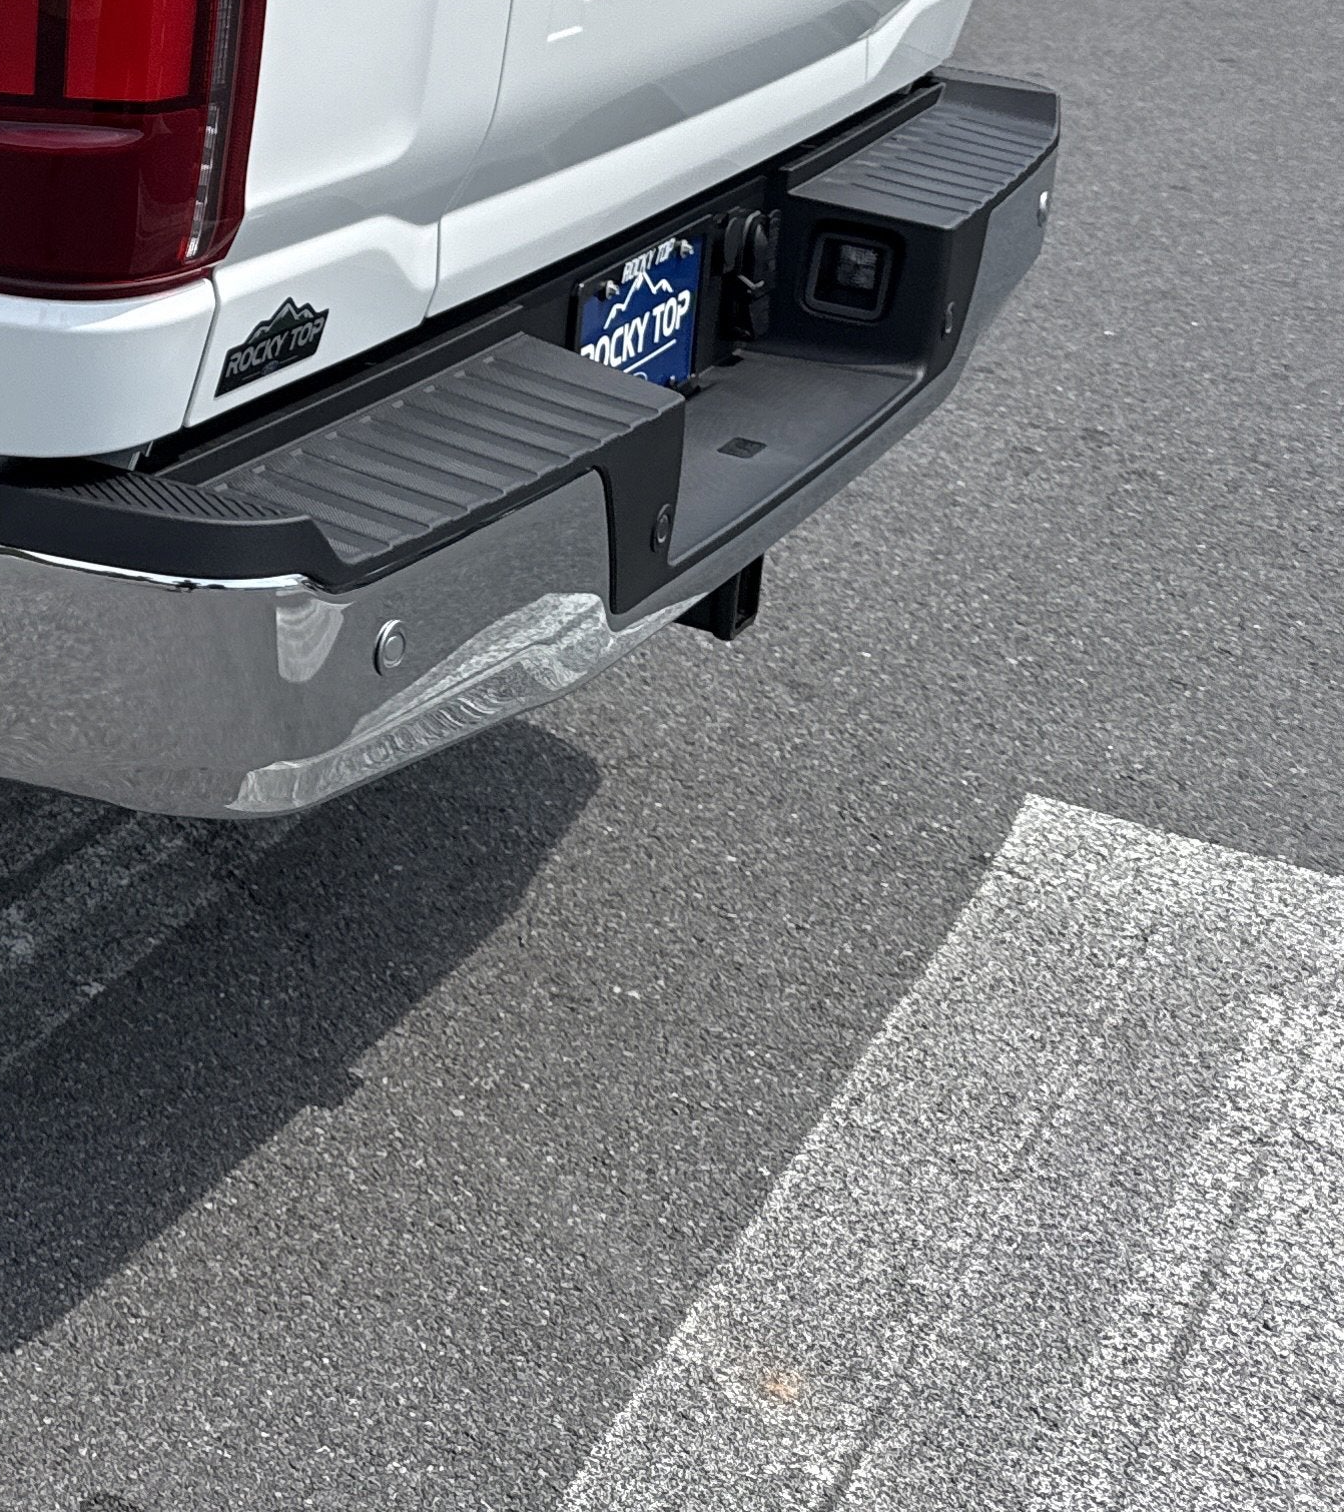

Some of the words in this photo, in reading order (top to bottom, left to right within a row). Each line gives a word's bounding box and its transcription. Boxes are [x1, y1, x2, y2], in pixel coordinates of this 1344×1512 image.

[652, 289, 690, 344] TOP
[225, 330, 290, 378] ROCKY
[289, 316, 325, 351] TOP
